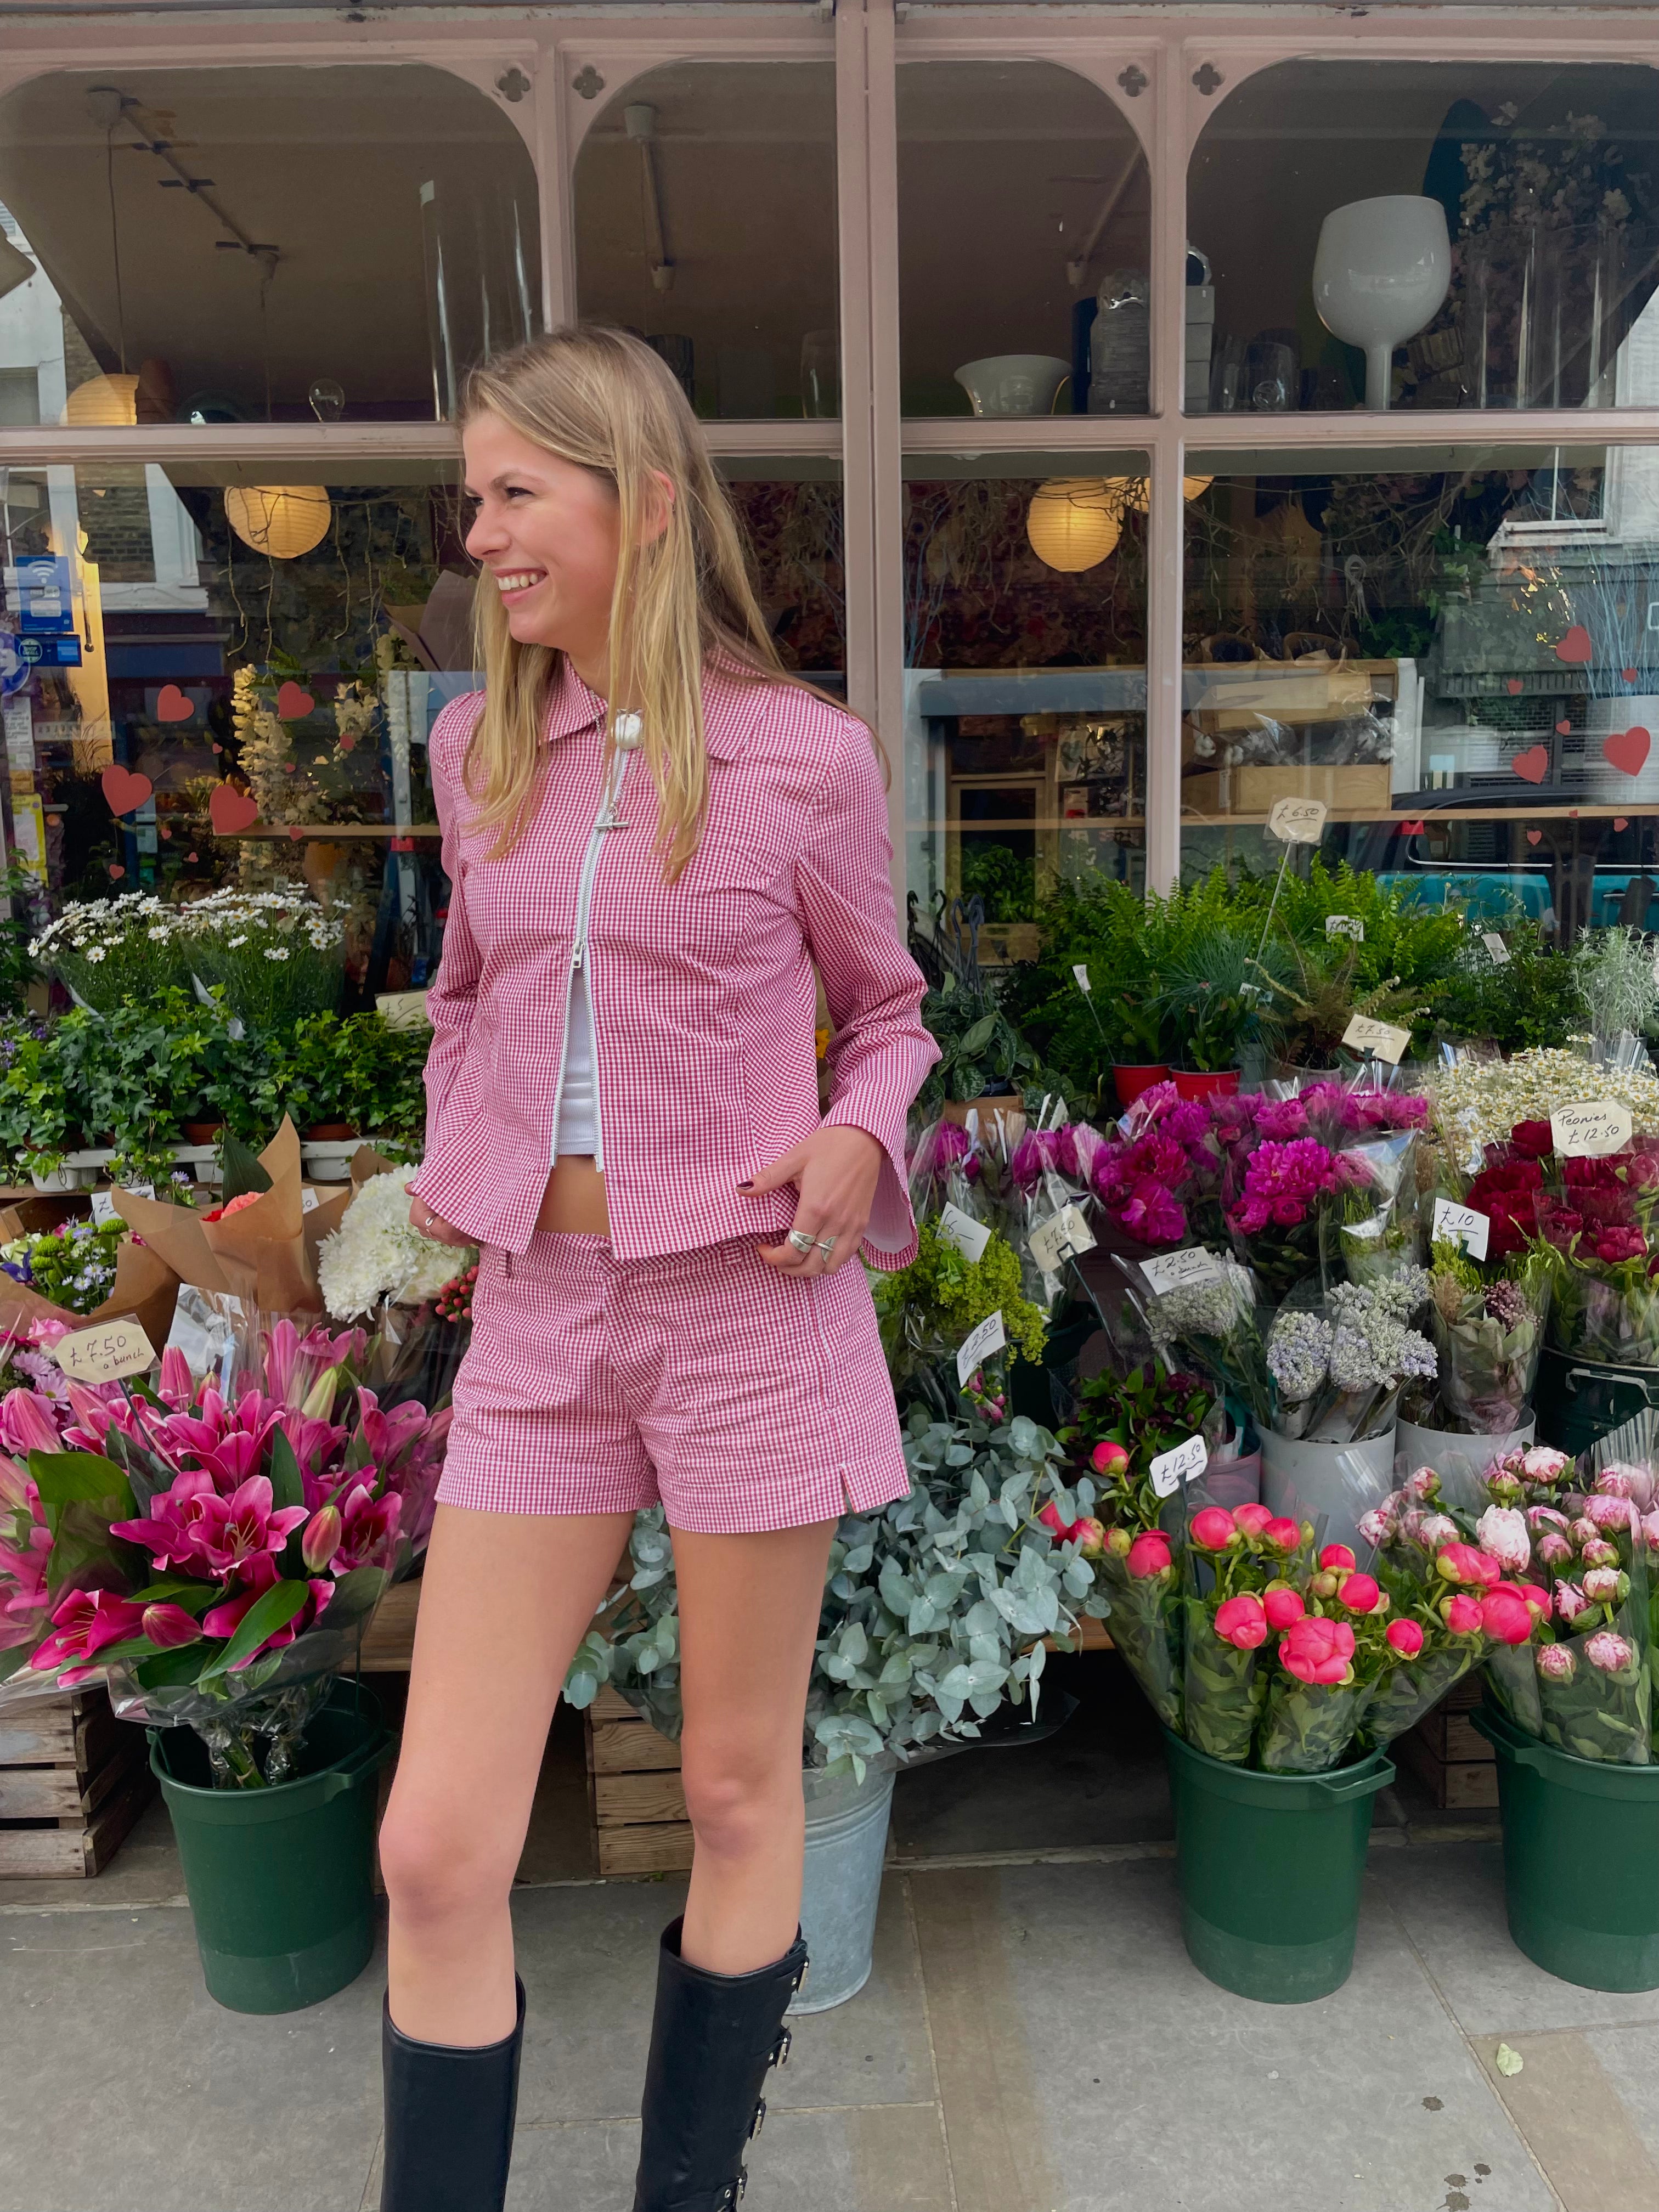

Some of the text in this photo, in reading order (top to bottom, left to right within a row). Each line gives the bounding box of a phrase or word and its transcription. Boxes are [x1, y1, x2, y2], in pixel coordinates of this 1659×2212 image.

[1355, 1023, 1390, 1035] £7.50
[1558, 1109, 1606, 1127] Peonies
[1568, 1124, 1619, 1144] £12.50
[1440, 1206, 1474, 1226] £10
[1152, 1251, 1195, 1277] £2.50
[70, 1335, 126, 1367] £7.50
[113, 1347, 144, 1366] bunch
[1161, 1443, 1201, 1483] £12.50
